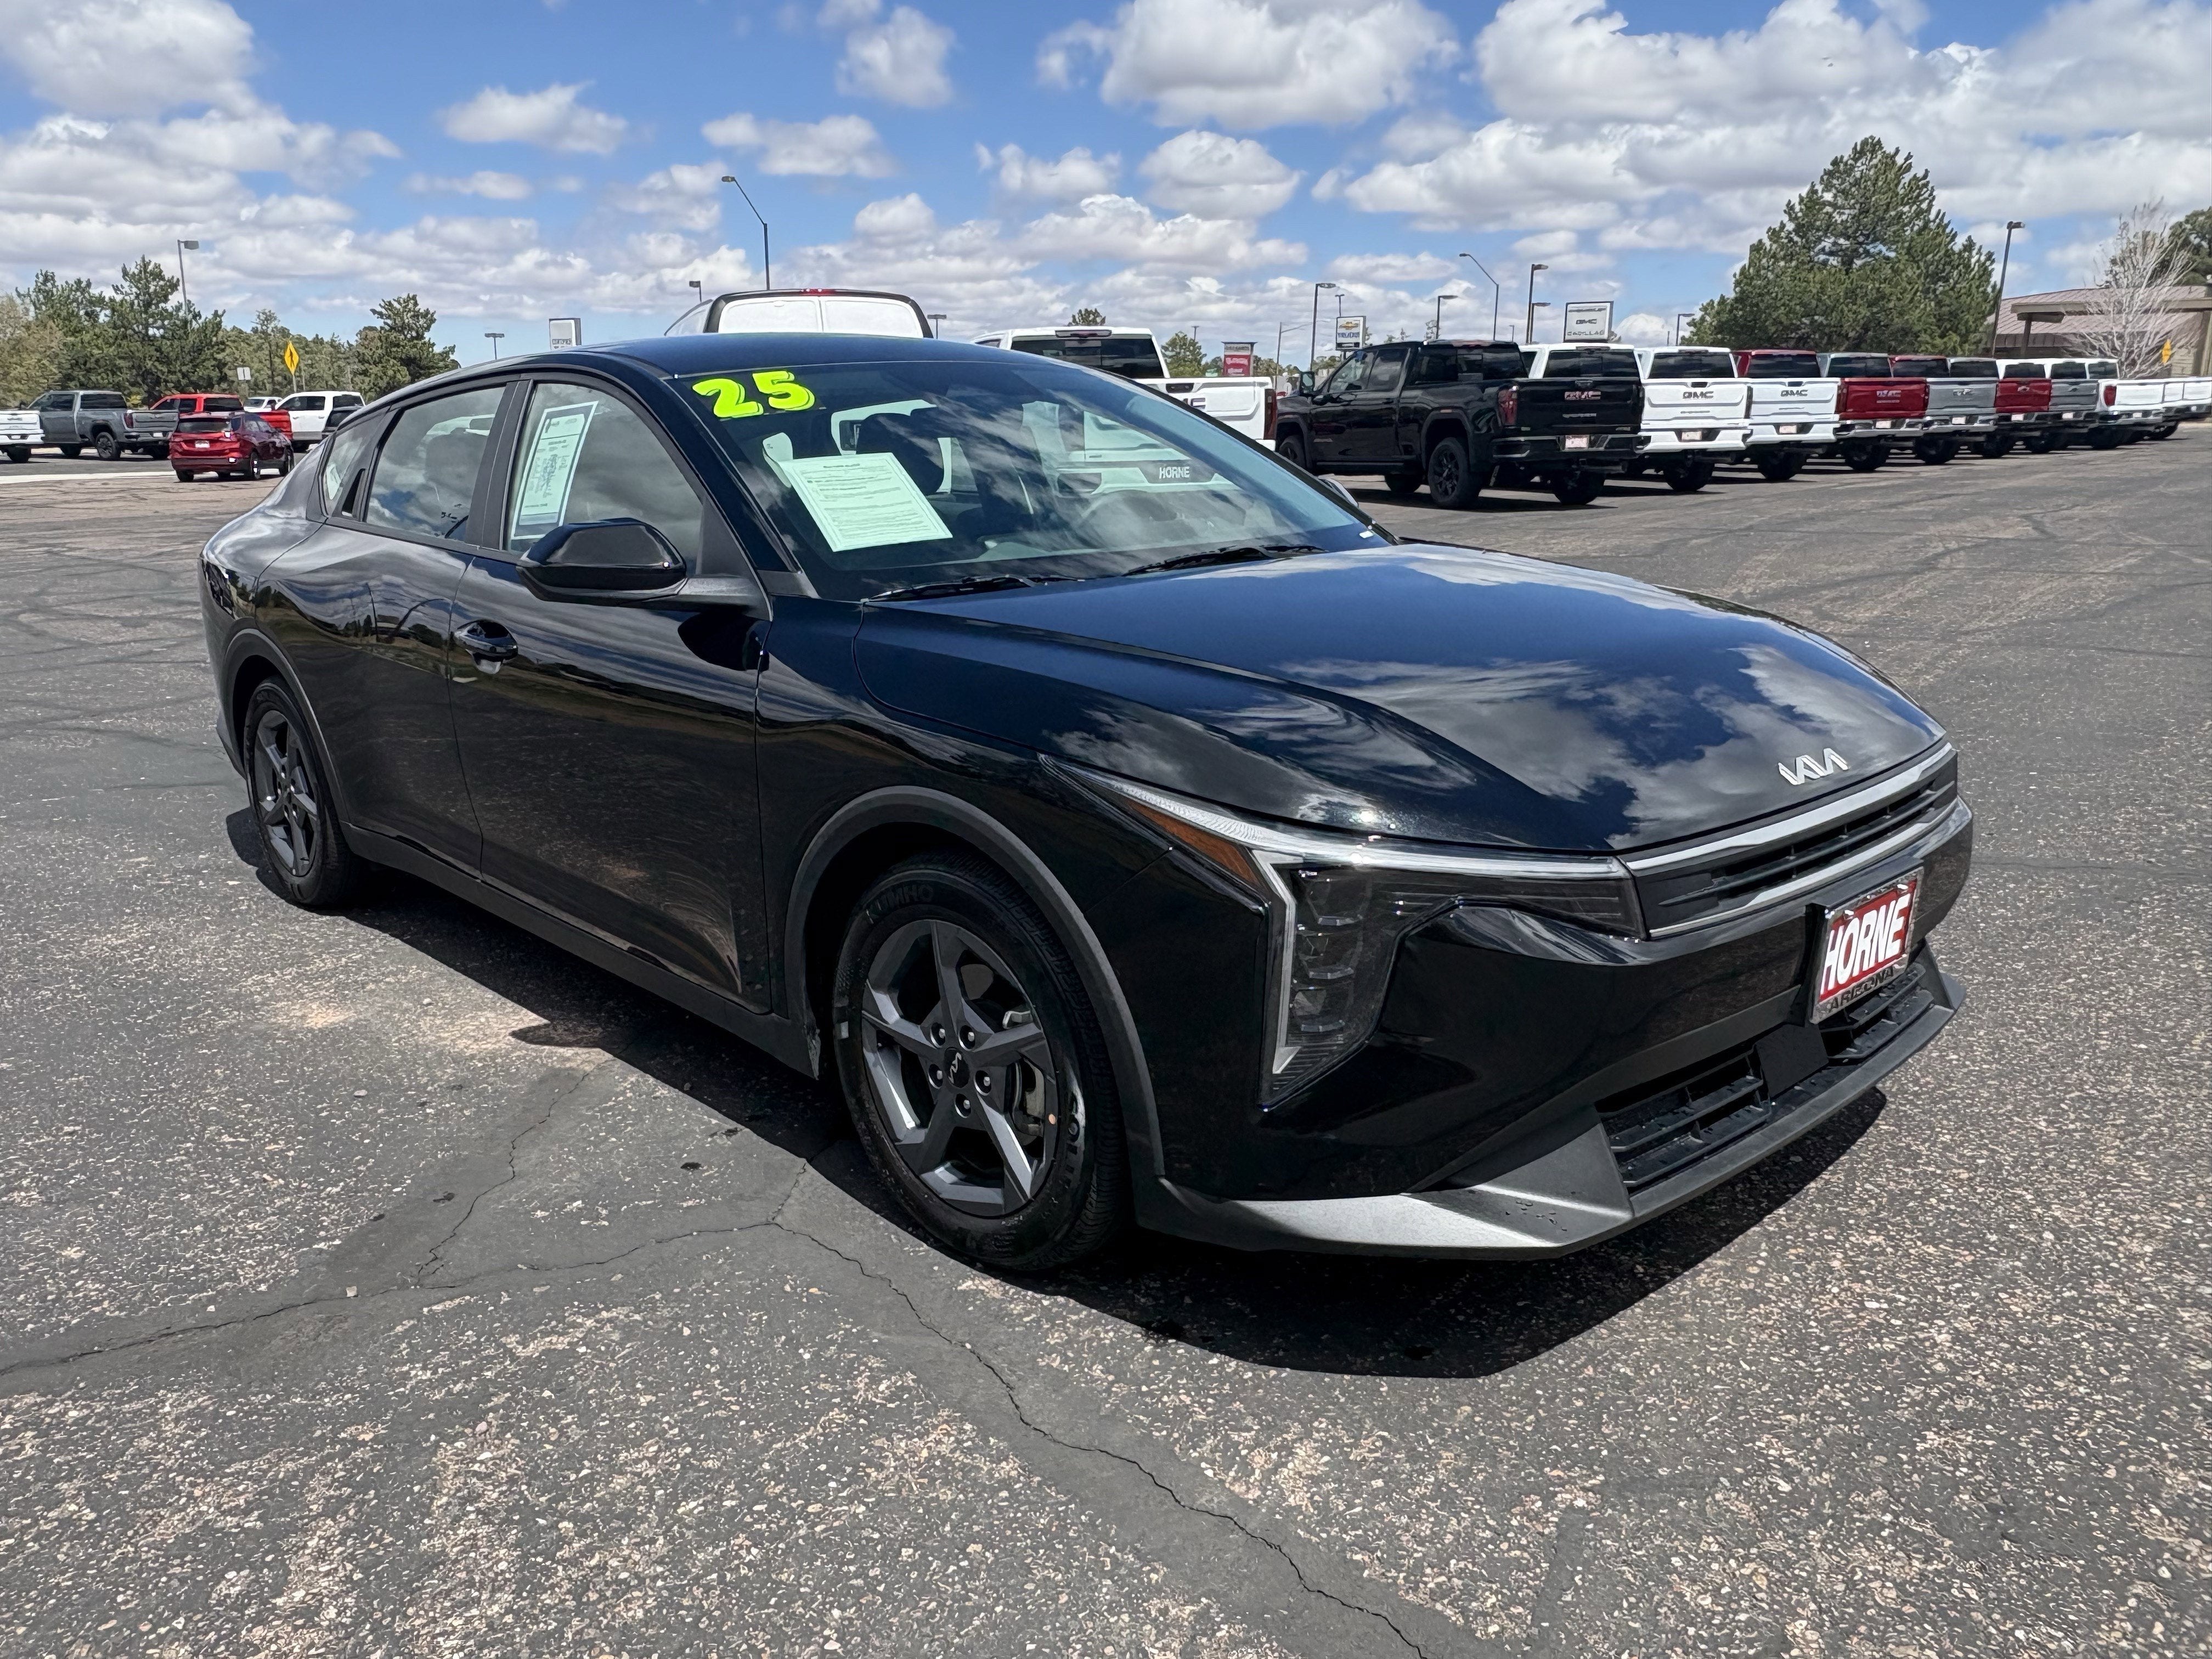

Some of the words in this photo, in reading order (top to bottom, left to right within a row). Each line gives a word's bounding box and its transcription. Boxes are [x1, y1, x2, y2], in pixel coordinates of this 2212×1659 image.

[692, 371, 815, 418] 25
[1159, 466, 1190, 479] HORNE
[1778, 748, 1848, 785] KIA
[1820, 894, 1911, 995] HORNE
